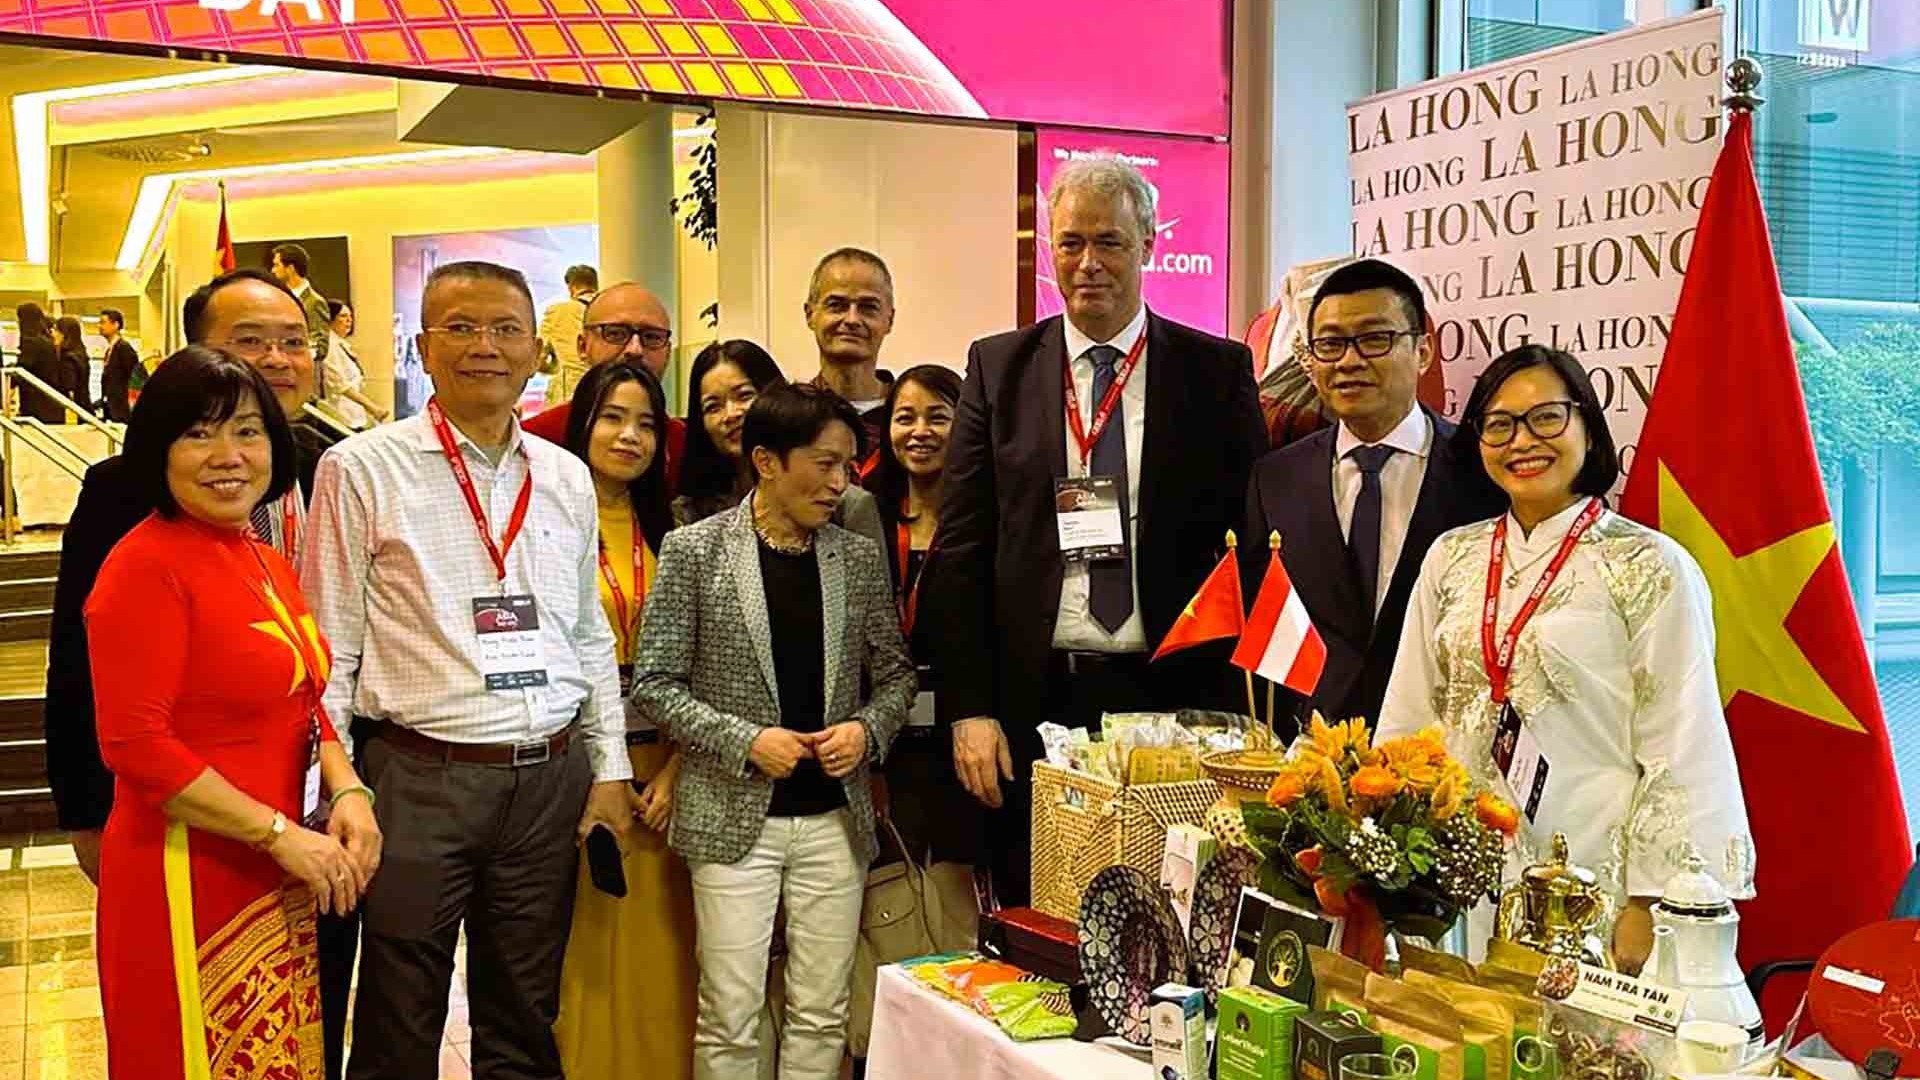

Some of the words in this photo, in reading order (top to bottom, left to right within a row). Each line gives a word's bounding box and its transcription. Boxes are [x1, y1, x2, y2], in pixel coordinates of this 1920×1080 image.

[1348, 107, 1393, 153] LA
[1406, 69, 1542, 140] HONG
[1560, 69, 1599, 106] LA
[1610, 42, 1721, 95] HONG
[1351, 176, 1376, 206] LA
[1384, 156, 1465, 198] HONG
[1480, 129, 1541, 181] LA
[1555, 94, 1721, 168] HONG
[1351, 217, 1391, 258] LA
[1403, 190, 1539, 251] HONG
[1554, 194, 1594, 230] LA
[1422, 272, 1463, 303] NG
[1477, 250, 1537, 299] LA
[1437, 313, 1533, 361] ONG
[1550, 322, 1587, 352] LA
[1597, 314, 1675, 351] HON
